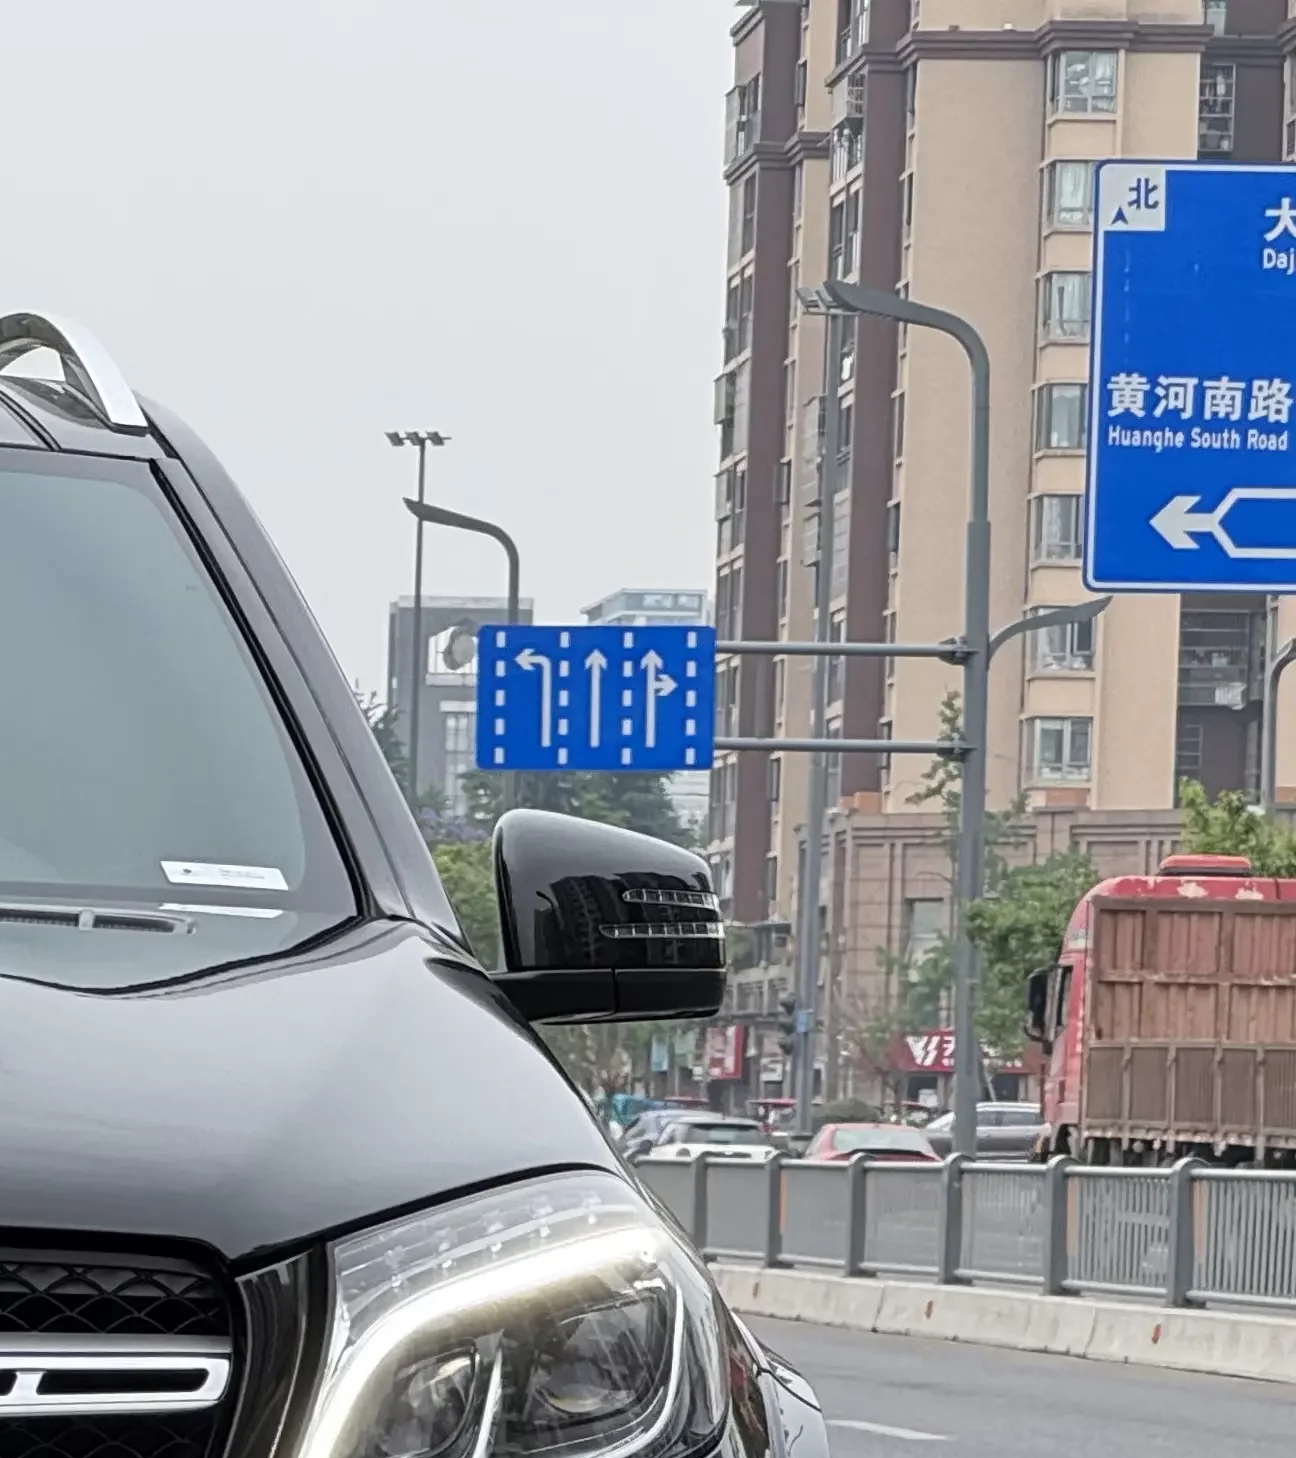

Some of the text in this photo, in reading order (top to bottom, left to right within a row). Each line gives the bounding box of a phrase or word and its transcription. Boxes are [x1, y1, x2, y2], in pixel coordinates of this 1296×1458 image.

[1128, 178, 1159, 210] 北
[1264, 197, 1296, 242] 大
[1107, 373, 1294, 423] 黄河南路
[1108, 425, 1288, 453] Huanghe South Road
